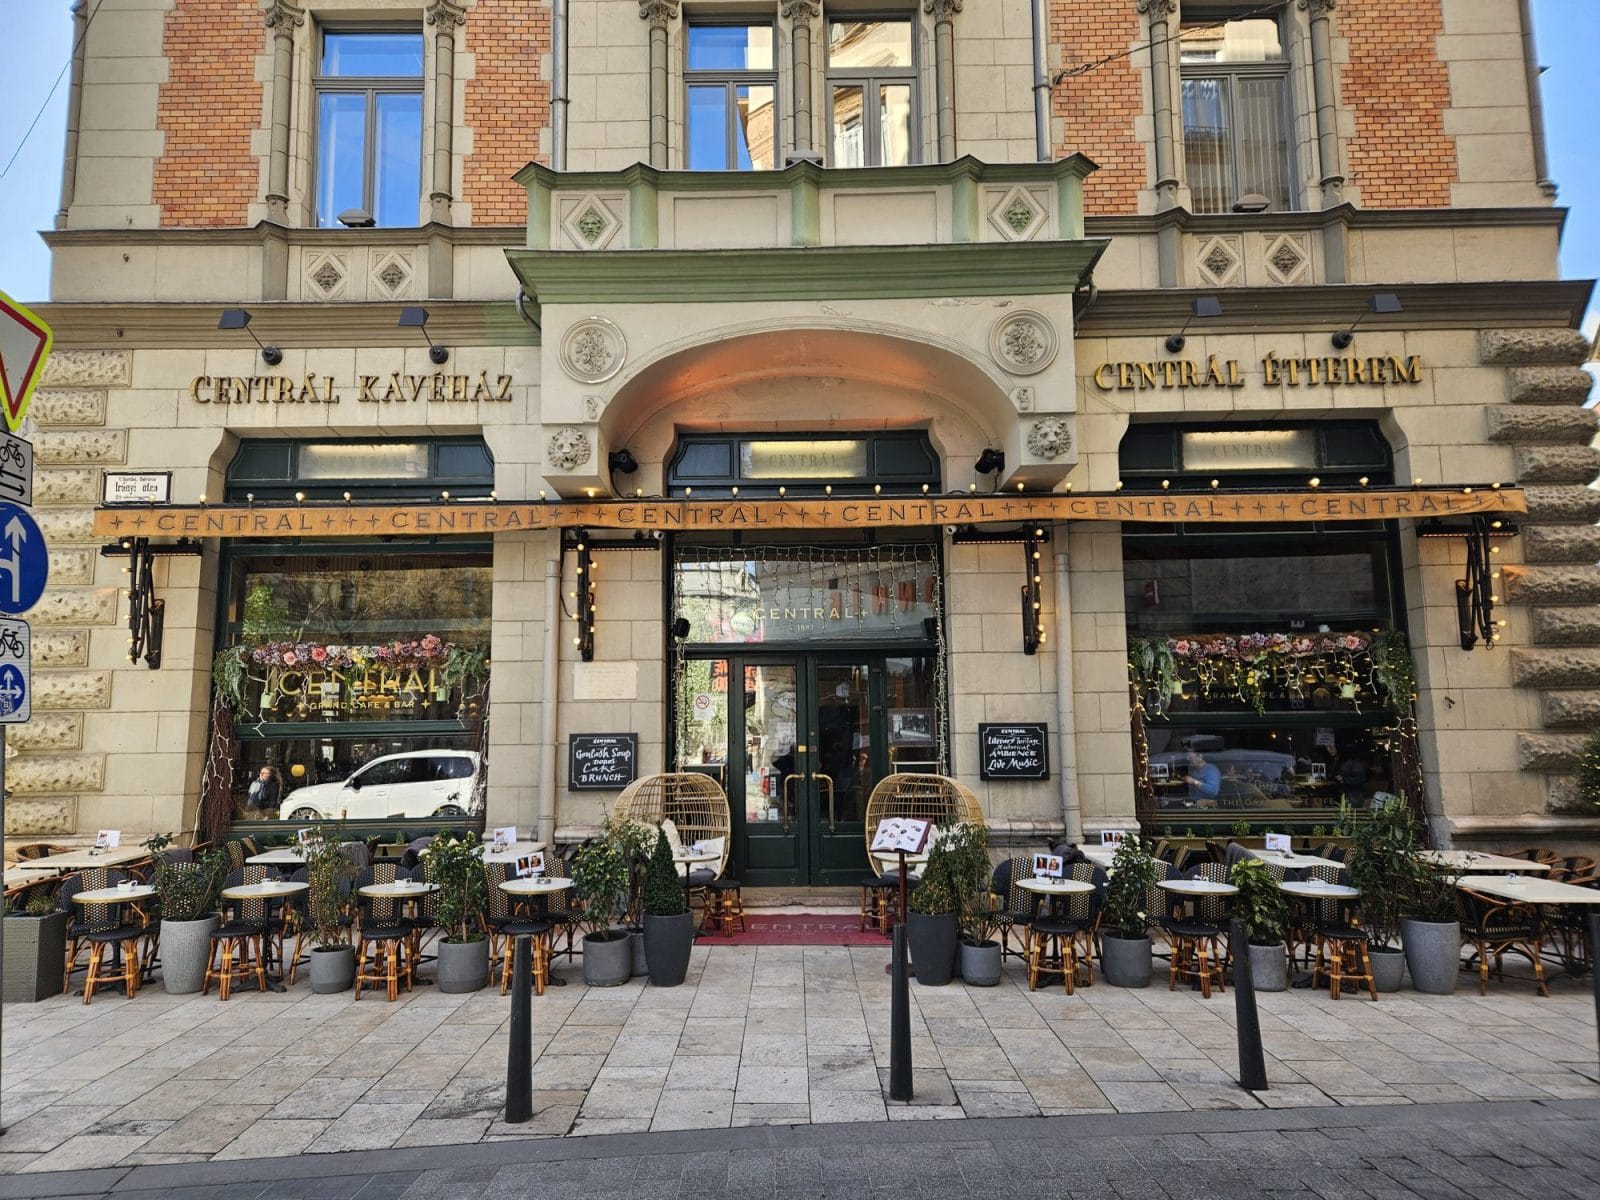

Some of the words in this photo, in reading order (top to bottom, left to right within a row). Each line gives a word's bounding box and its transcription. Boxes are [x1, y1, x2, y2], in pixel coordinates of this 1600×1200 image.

[1094, 354, 1245, 391] CENTRÁL
[1261, 350, 1422, 386] ÉTTEREM
[190, 372, 340, 404] CENTRÁL
[358, 370, 512, 403] KÁVÉHÁZ
[842, 503, 994, 521] CENTRAL
[1070, 501, 1223, 517] CENTRAL
[1301, 496, 1461, 515] CENTRAL
[157, 513, 312, 531] CENTRAL
[391, 509, 542, 528] CENTRAL
[618, 506, 767, 524] CENTRAL
[753, 607, 854, 620] CENTRAL
[611, 747, 631, 761] Soup
[583, 762, 628, 773] Cake
